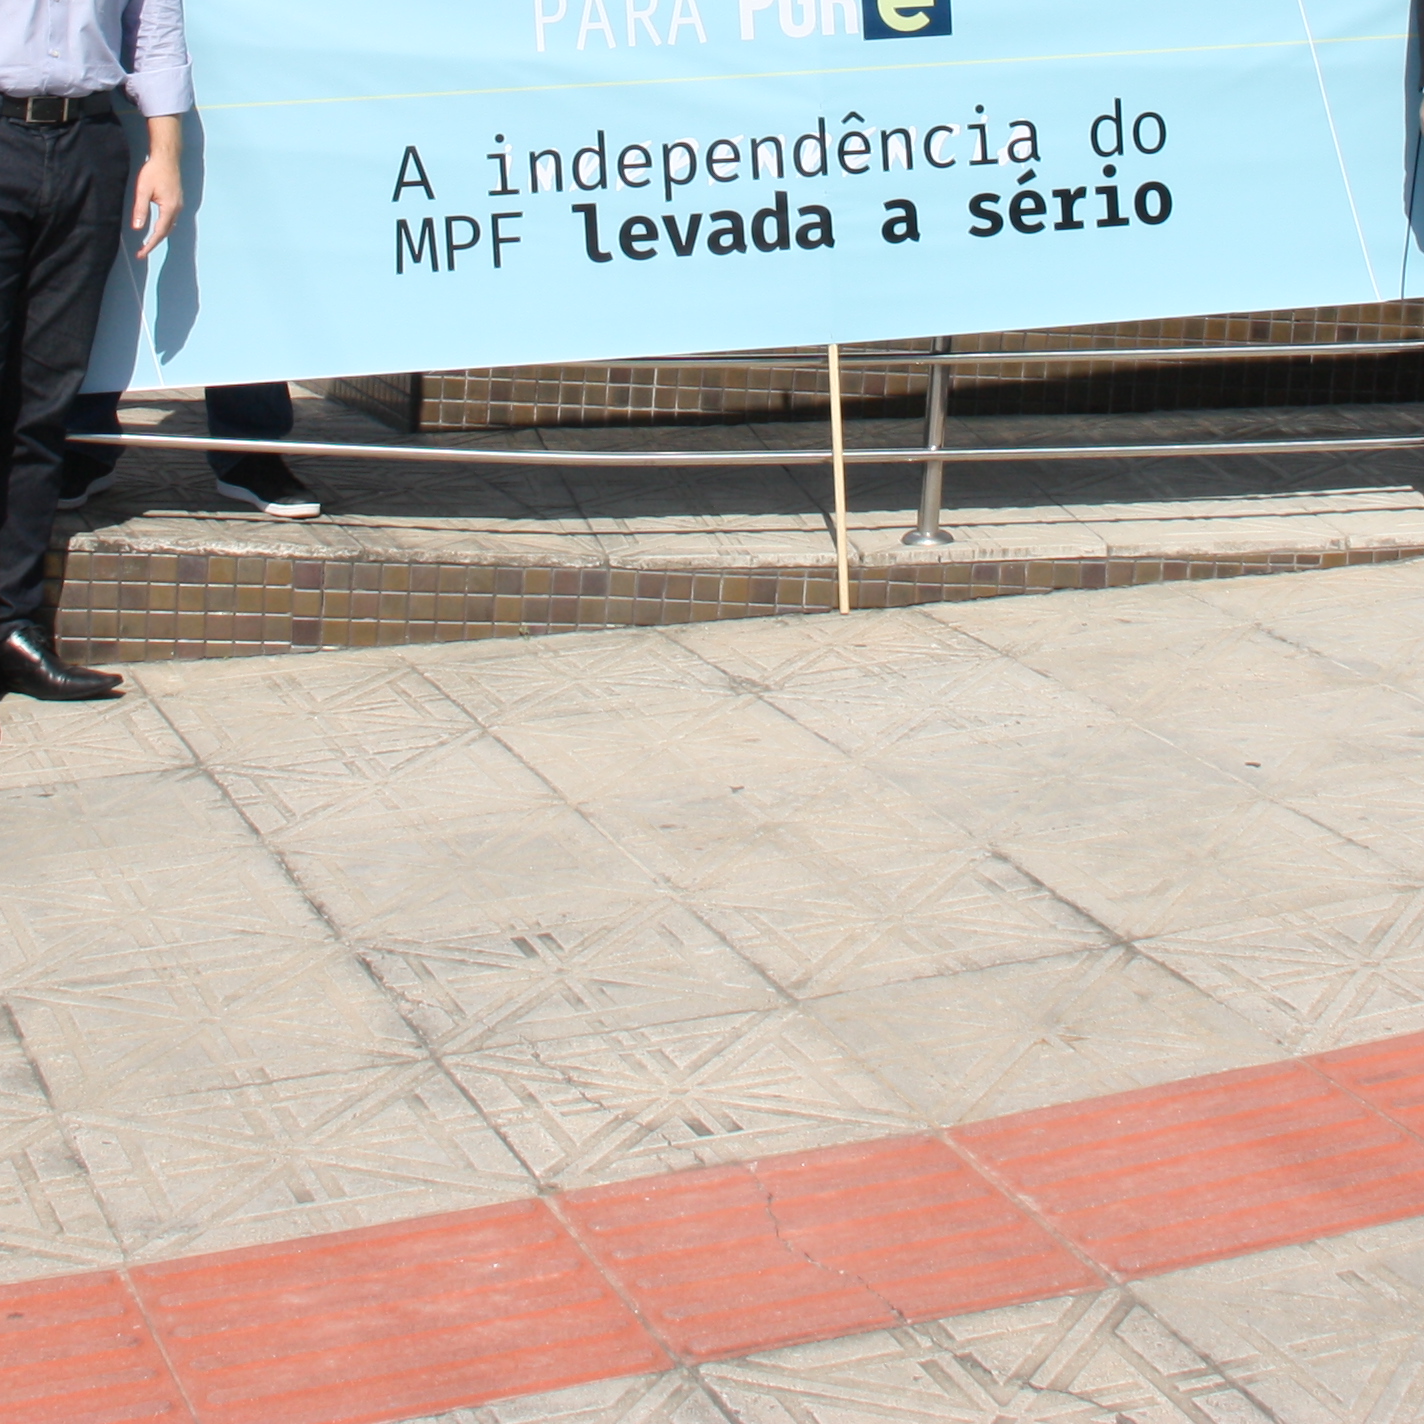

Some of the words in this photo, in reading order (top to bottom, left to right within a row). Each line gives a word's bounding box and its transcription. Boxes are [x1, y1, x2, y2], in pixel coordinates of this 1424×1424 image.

[391, 145, 436, 203] A
[487, 102, 1042, 201] independência
[1090, 96, 1168, 158] do
[394, 211, 524, 275] MPF
[571, 189, 837, 264] levada
[880, 194, 922, 245] a
[967, 165, 1174, 239] sério
